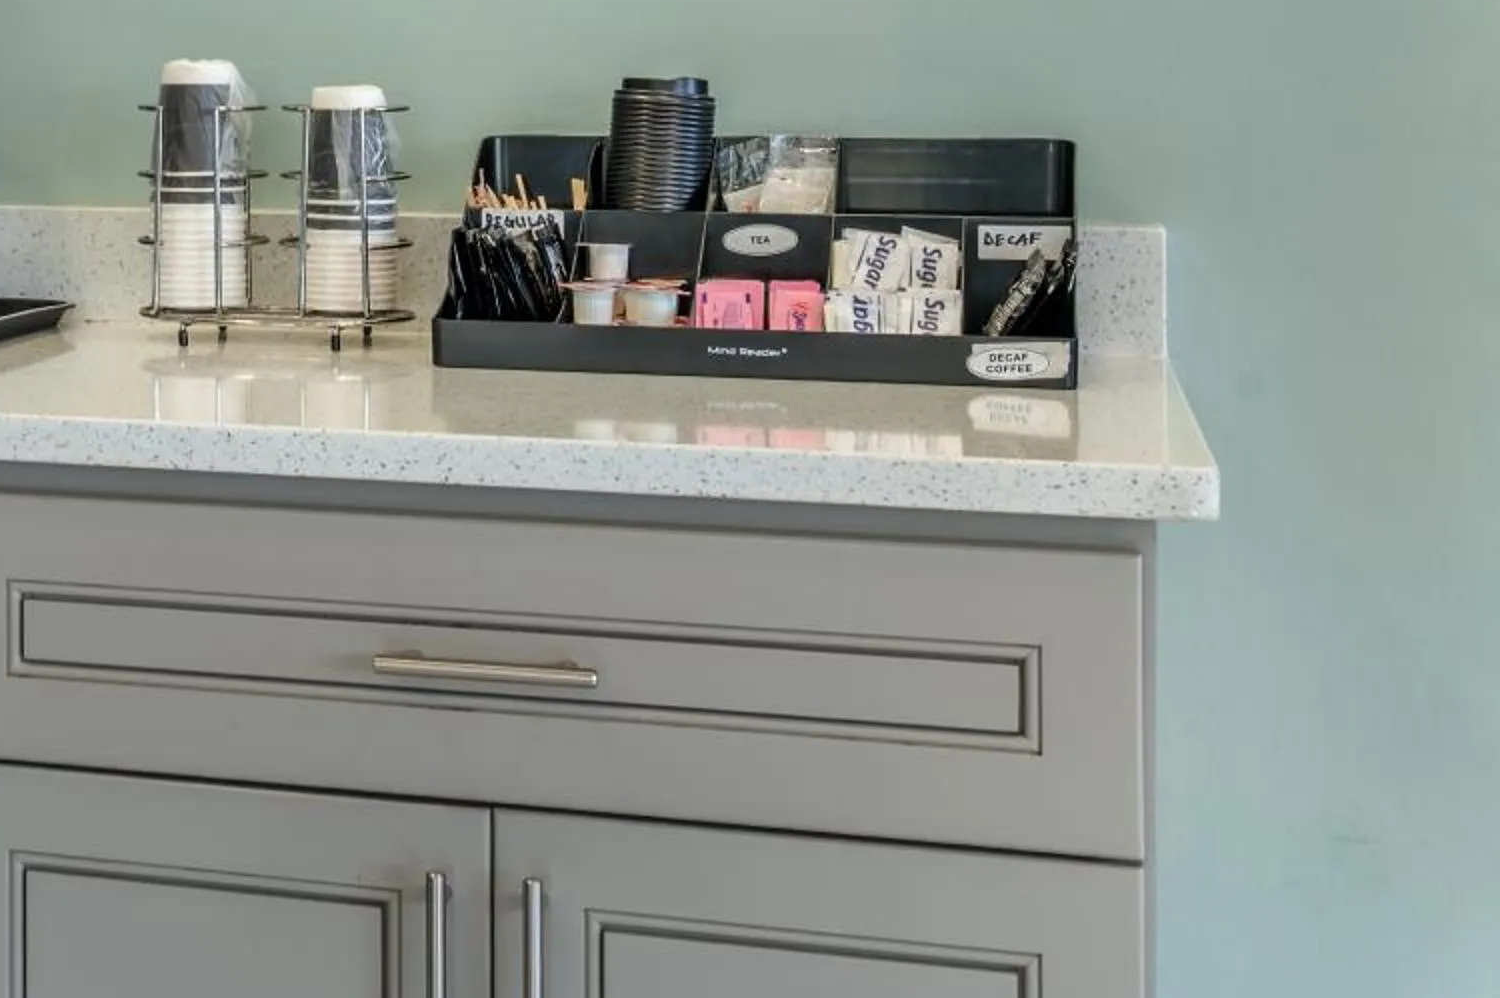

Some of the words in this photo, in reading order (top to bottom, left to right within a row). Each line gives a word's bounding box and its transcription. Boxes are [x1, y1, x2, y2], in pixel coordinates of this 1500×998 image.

[751, 235, 771, 245] TEA
[983, 230, 1043, 247] DECAF
[863, 235, 898, 290] Sugar
[985, 364, 1033, 374] COFFEE
